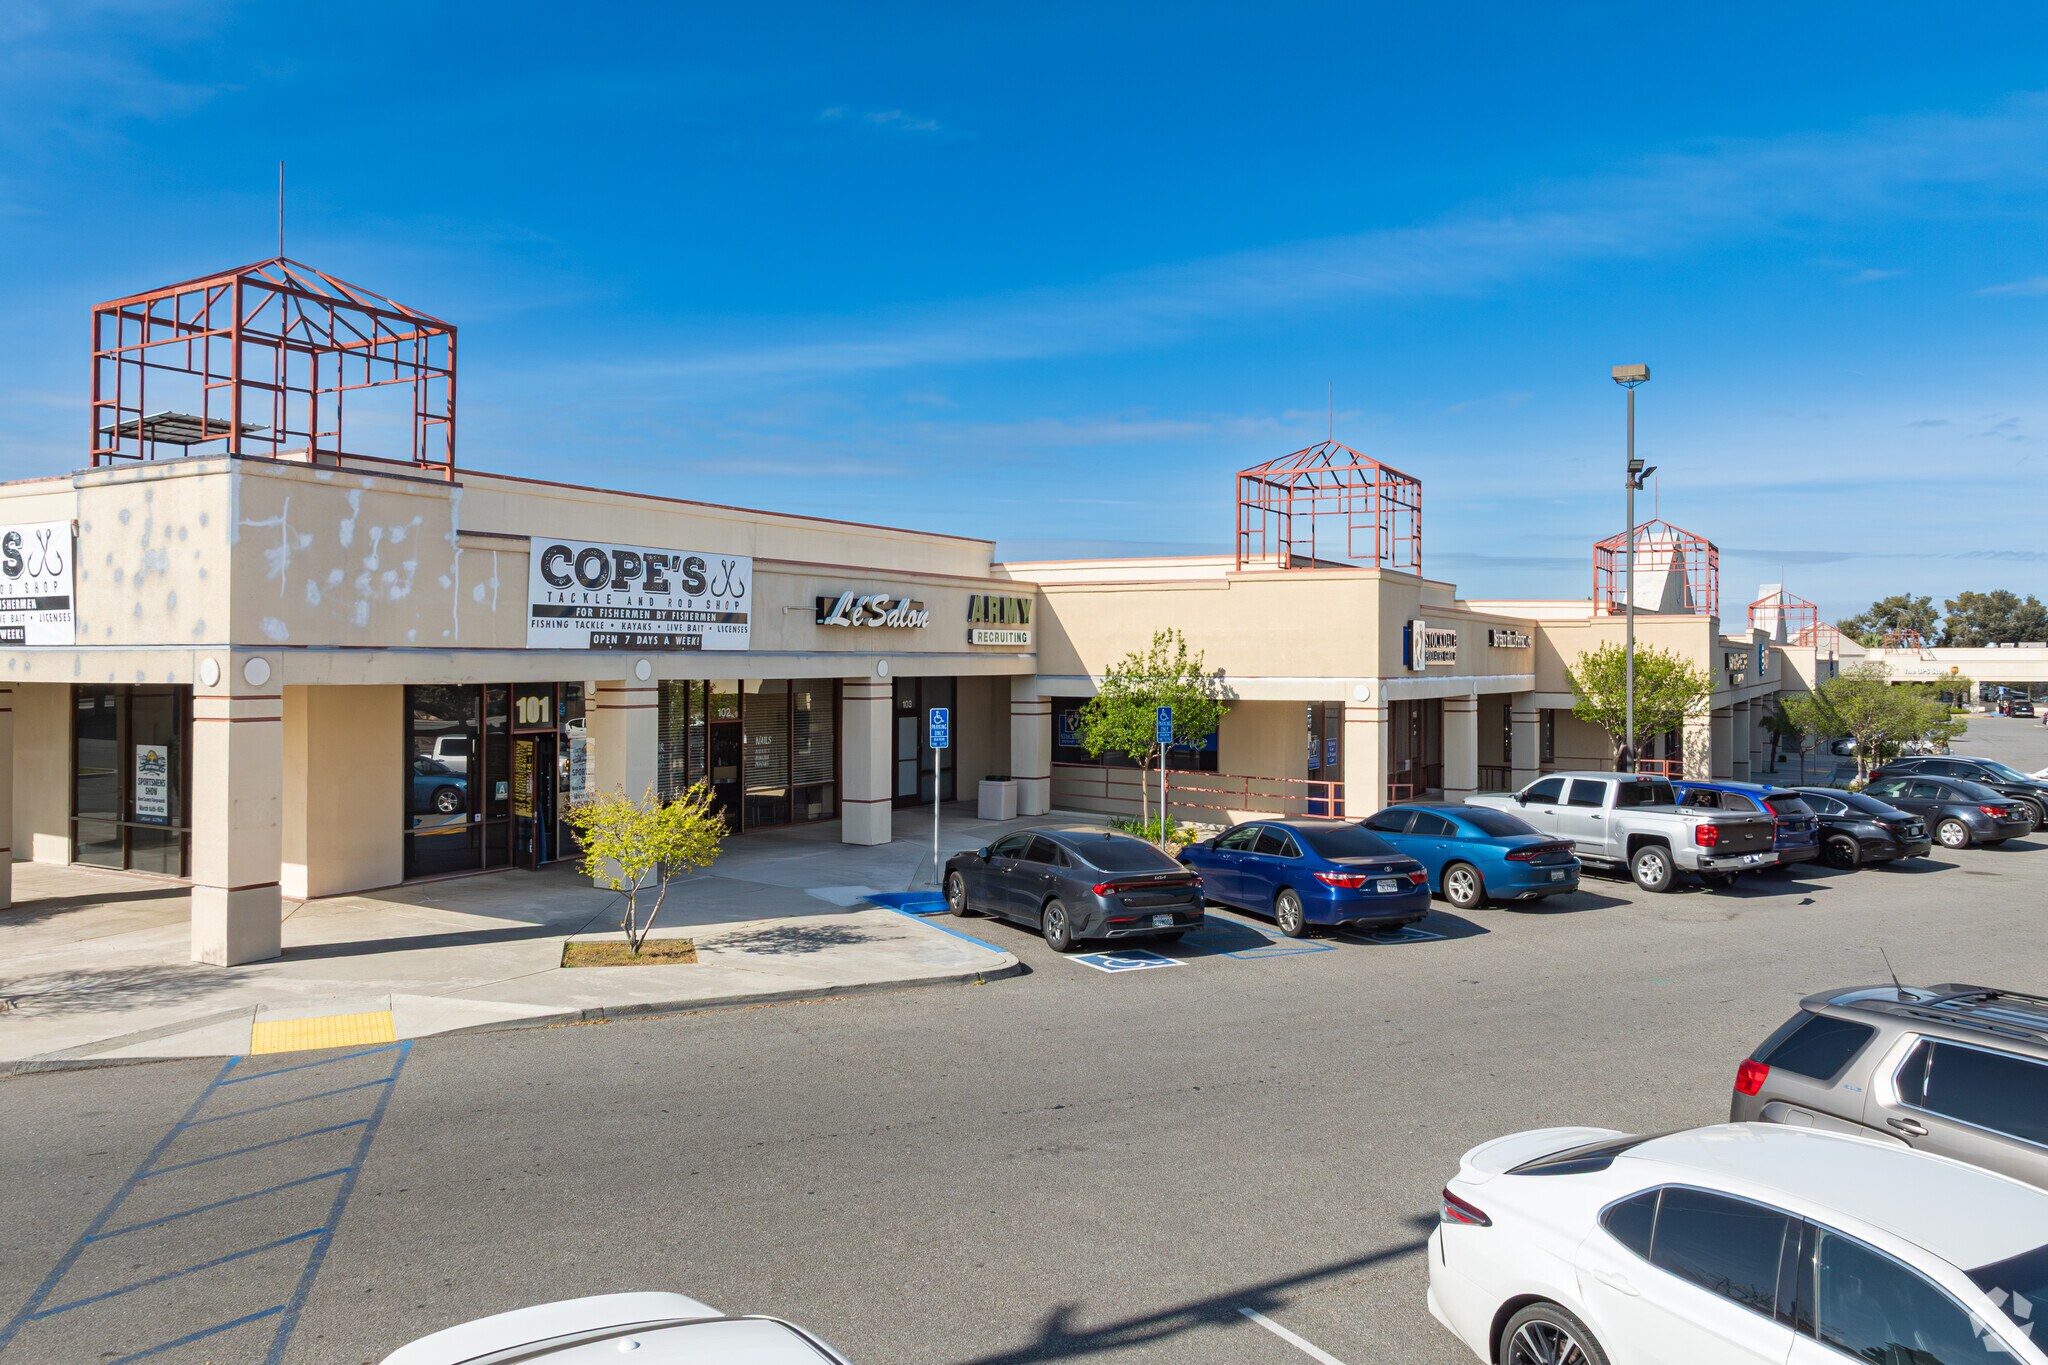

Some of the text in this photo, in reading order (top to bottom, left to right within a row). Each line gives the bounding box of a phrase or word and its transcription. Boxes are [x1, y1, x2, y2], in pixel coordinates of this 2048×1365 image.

[541, 545, 707, 597] COPE'S
[24, 581, 58, 593] SHOP
[547, 591, 739, 611] TACKLE AND ROD SHOP
[576, 608, 717, 621] FOR FISHERMEN BY FISHERMEN
[866, 593, 930, 629] Salon
[968, 594, 1033, 624] ARMY
[11, 613, 25, 623] BAIT
[39, 612, 71, 622] LICENSES
[531, 619, 748, 633] FISHING TACKLE KAYAKS LIVE BAIT LICENSES
[593, 634, 700, 645] OPEN 7 DAYS A WEEK!
[976, 631, 1028, 644] RECRUITING
[516, 696, 550, 723] 101
[902, 700, 912, 708] 103
[718, 707, 731, 718] 102
[755, 735, 772, 746] NAILS
[137, 777, 165, 788] SPORTSMENS
[145, 787, 158, 796] SHOW
[498, 784, 506, 794] A
